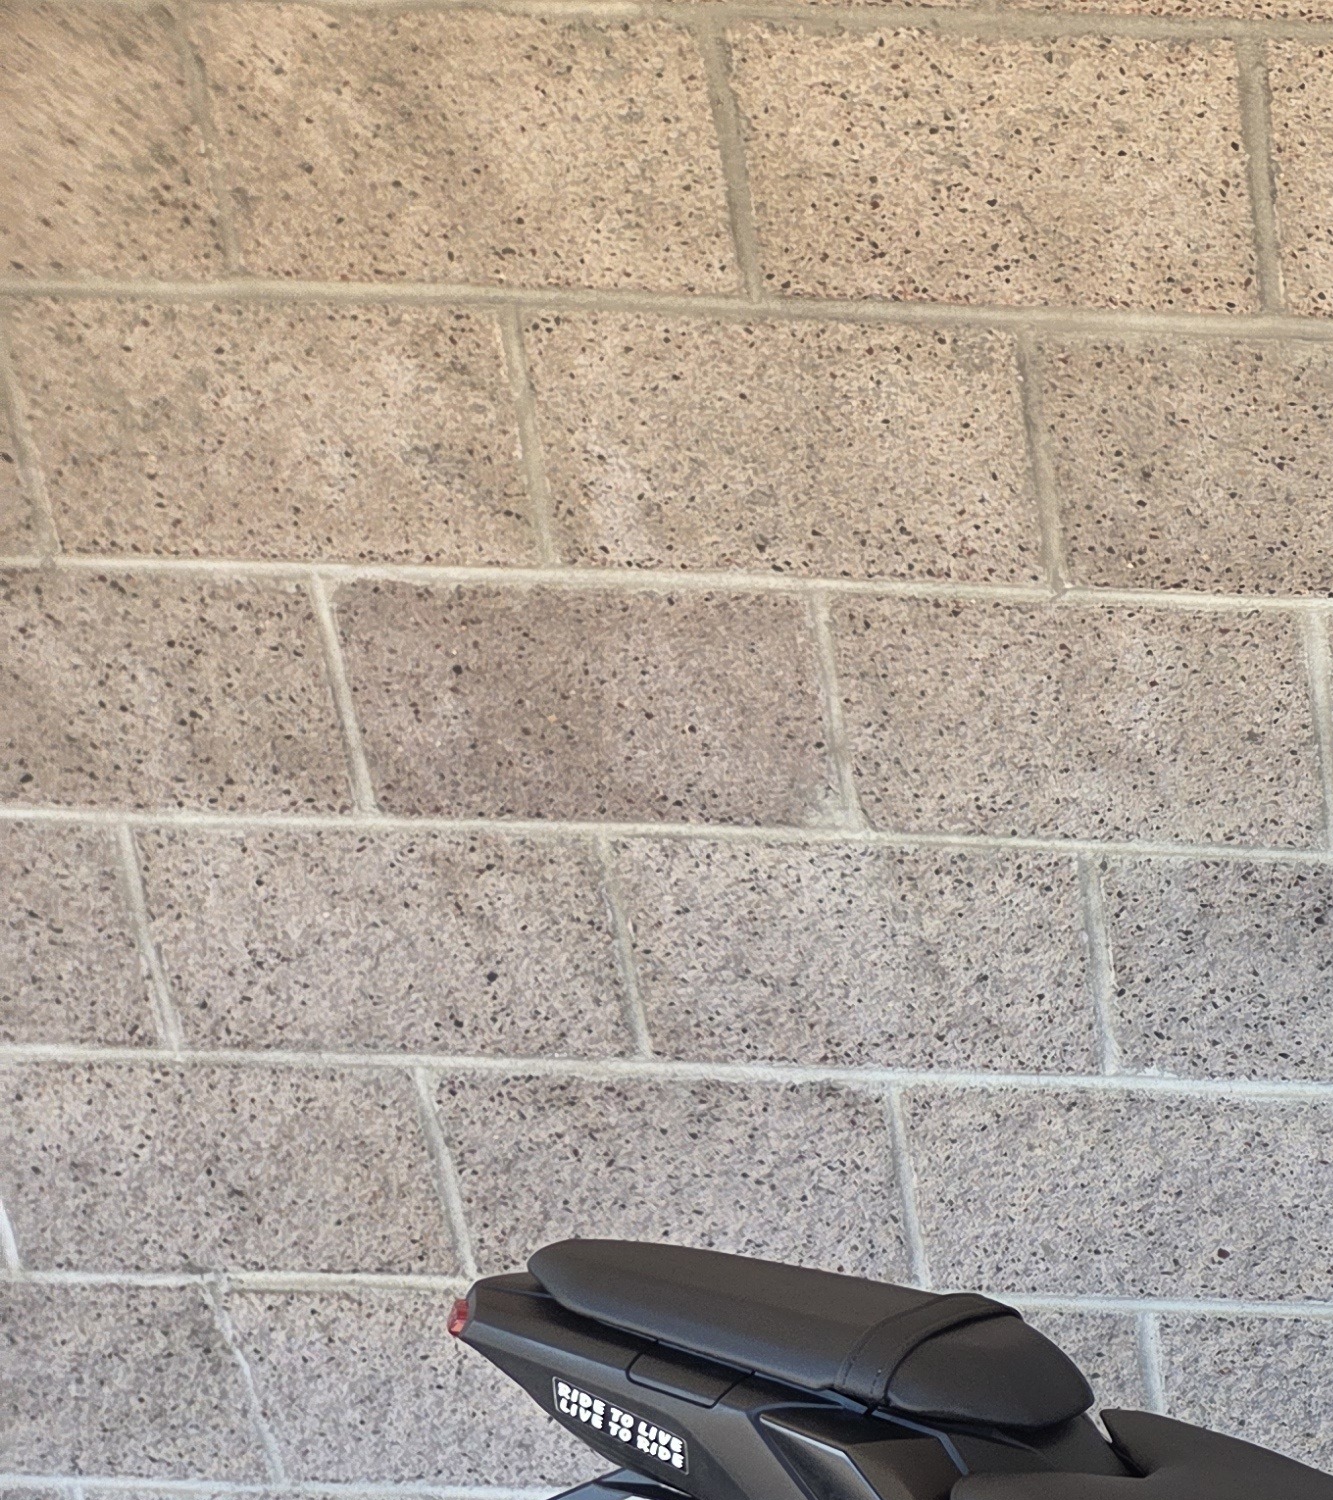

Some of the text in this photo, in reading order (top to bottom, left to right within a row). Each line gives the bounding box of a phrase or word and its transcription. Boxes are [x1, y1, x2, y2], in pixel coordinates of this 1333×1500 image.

[557, 1382, 683, 1453] RIDE TO LIVE
[559, 1397, 684, 1468] LIVE TO RIDE
